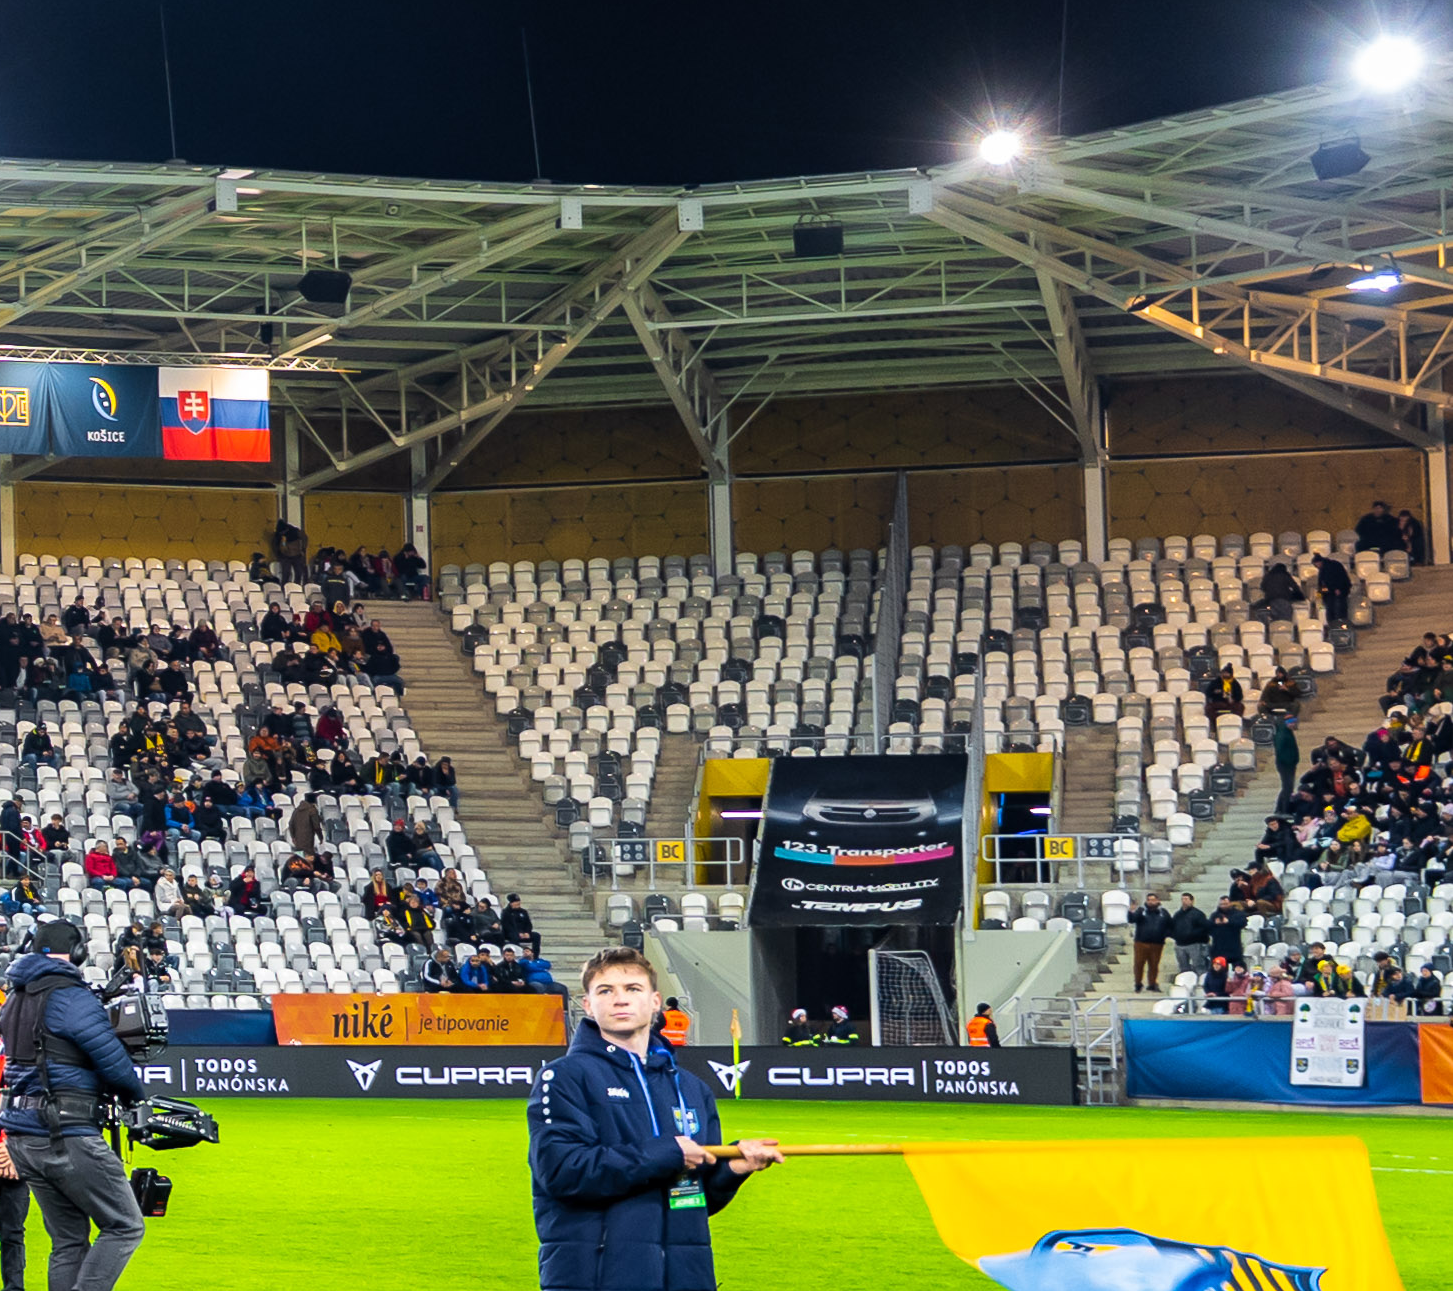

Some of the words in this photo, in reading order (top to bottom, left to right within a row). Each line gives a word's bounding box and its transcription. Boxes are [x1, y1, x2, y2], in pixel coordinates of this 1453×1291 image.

[87, 429, 125, 443] KOŠICE
[661, 844, 680, 858] BC
[782, 840, 948, 858] 123-Transporter
[1049, 840, 1068, 855] BC
[800, 899, 924, 912] TEMPUS
[332, 1001, 393, 1039] niké
[418, 1013, 433, 1034] je
[436, 1013, 509, 1035] tipovanie
[195, 1058, 258, 1074] TODOS
[934, 1060, 991, 1076] TODOS
[195, 1073, 290, 1093] PANÓNSKA
[394, 1065, 533, 1086] CUPRA
[768, 1066, 915, 1086] CUPRA
[935, 1076, 1021, 1096] PANÓNSKA
